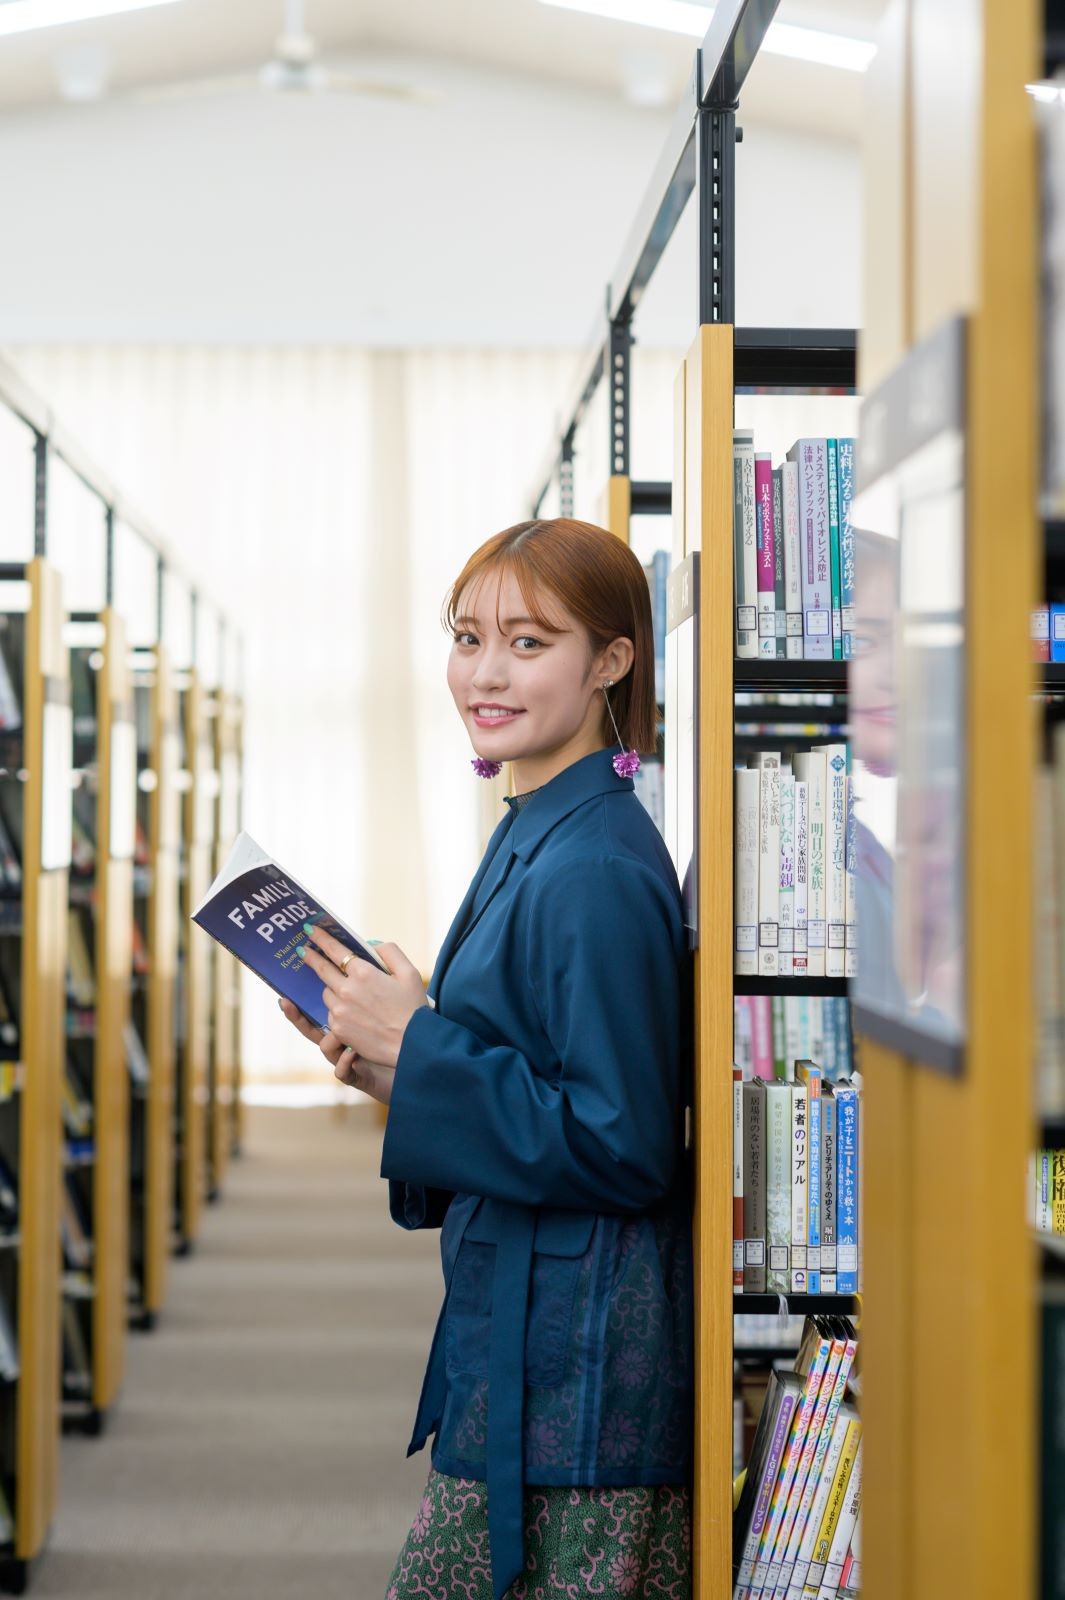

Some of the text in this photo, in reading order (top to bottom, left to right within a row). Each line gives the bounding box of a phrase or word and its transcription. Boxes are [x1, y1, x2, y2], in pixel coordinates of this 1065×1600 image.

[804, 445, 814, 517] 法律ハンドブック
[816, 445, 827, 582] ドメスティック・バイオレンス防止
[762, 483, 772, 568] 日本のポストフェミニズム
[780, 781, 794, 888] 気づけない毒親
[811, 822, 823, 890] 明日の家族
[832, 774, 844, 871] 都市環境と子育て
[228, 880, 295, 930] FAMILY
[256, 900, 317, 944] PRIDE
[274, 944, 292, 960] What
[750, 1096, 760, 1187] 居場所のない若者たち
[795, 1098, 806, 1185] 若者のリアル
[825, 1135, 833, 1221] スピリチュアリティのゆくえ
[844, 1106, 855, 1226] 我が子をニートから救う本
